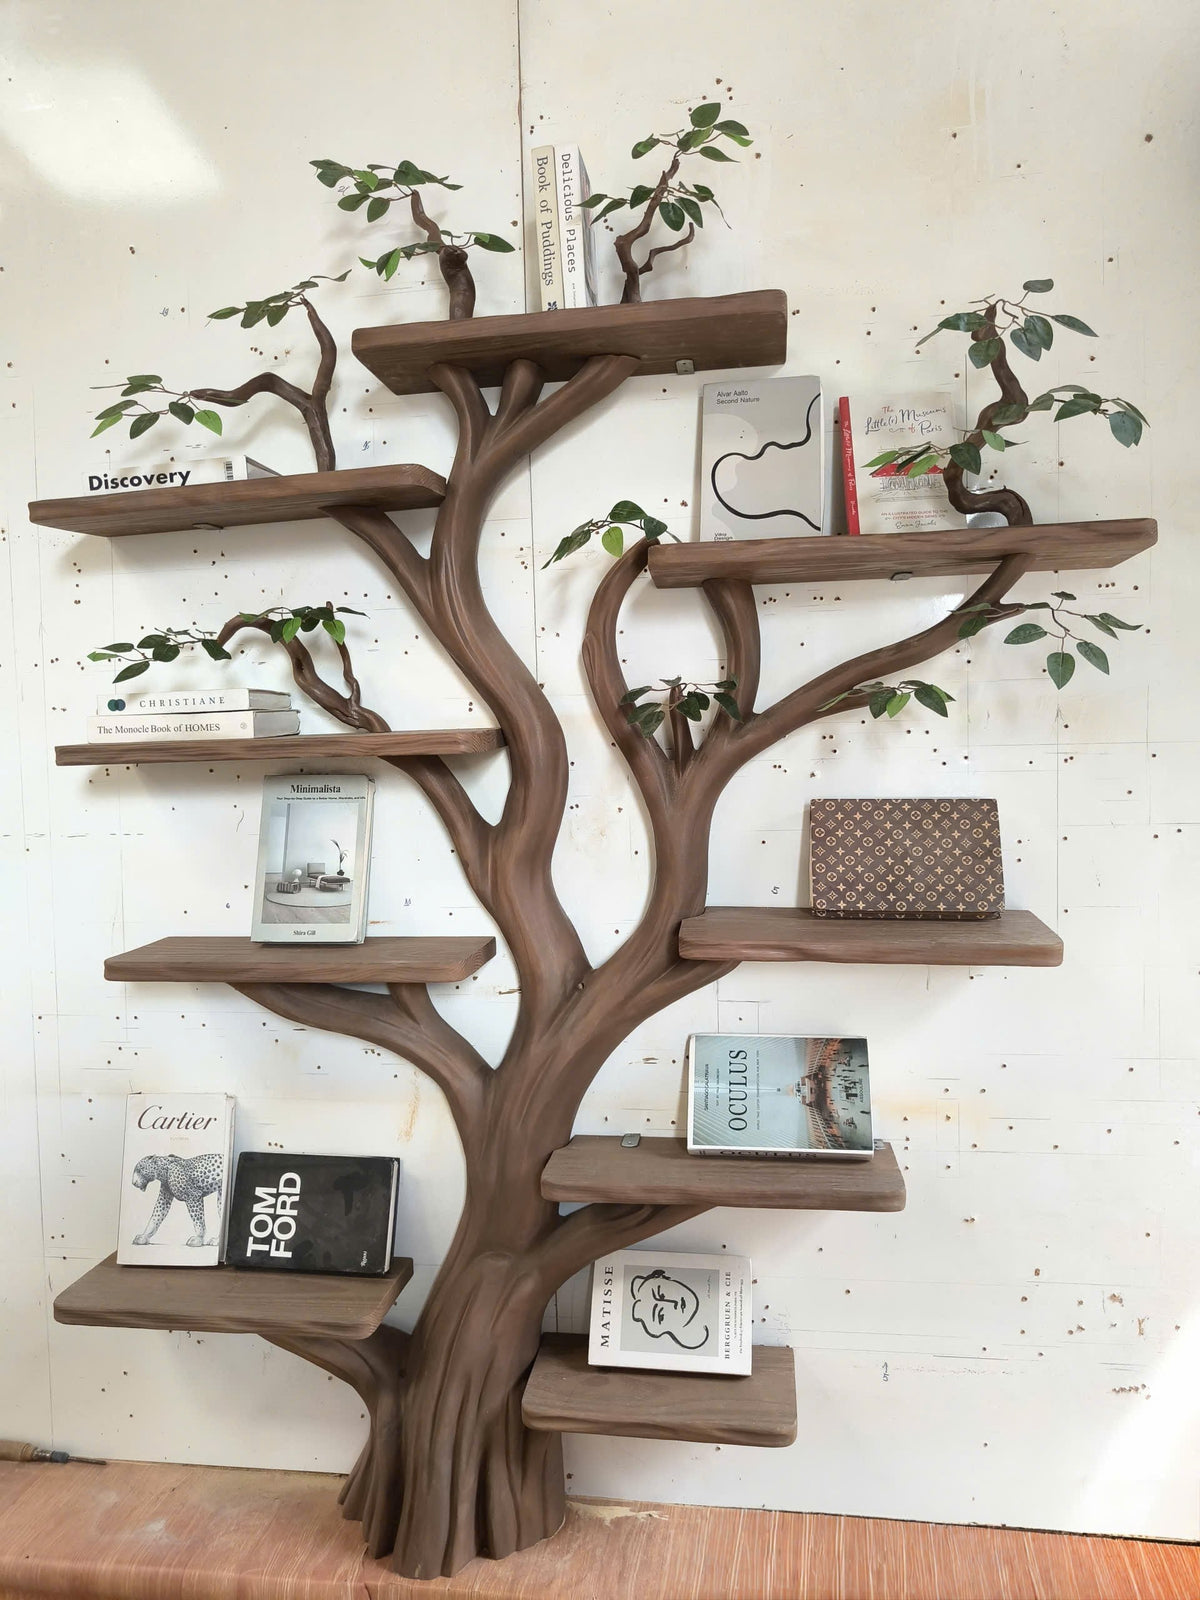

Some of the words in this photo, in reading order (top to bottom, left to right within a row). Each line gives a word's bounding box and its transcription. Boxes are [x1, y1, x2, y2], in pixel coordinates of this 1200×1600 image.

[536, 155, 551, 193] Book
[561, 153, 573, 222] Delicious
[539, 199, 553, 214] of
[541, 220, 556, 287] Puddings
[566, 229, 577, 273] Places
[716, 390, 733, 398] Alvar
[733, 389, 749, 397] Aalto
[739, 396, 760, 404] Nature
[865, 415, 898, 435] Little(r)
[899, 406, 947, 423] Museums
[881, 406, 894, 414] The
[908, 425, 916, 434] of
[918, 419, 943, 436] Paris
[88, 470, 191, 492] Discovery
[139, 696, 226, 708] CHRISTIANE
[97, 725, 113, 735] The
[114, 724, 149, 734] Monocle
[150, 723, 172, 733] Book
[173, 723, 184, 732] of
[184, 723, 221, 732] HOMES
[290, 784, 341, 794] Minimalista
[728, 1049, 748, 1131] OCULUS
[137, 1104, 217, 1131] Cartier
[246, 1186, 278, 1257] TOM
[269, 1172, 301, 1258] FORD
[600, 1266, 614, 1348] MATISSE
